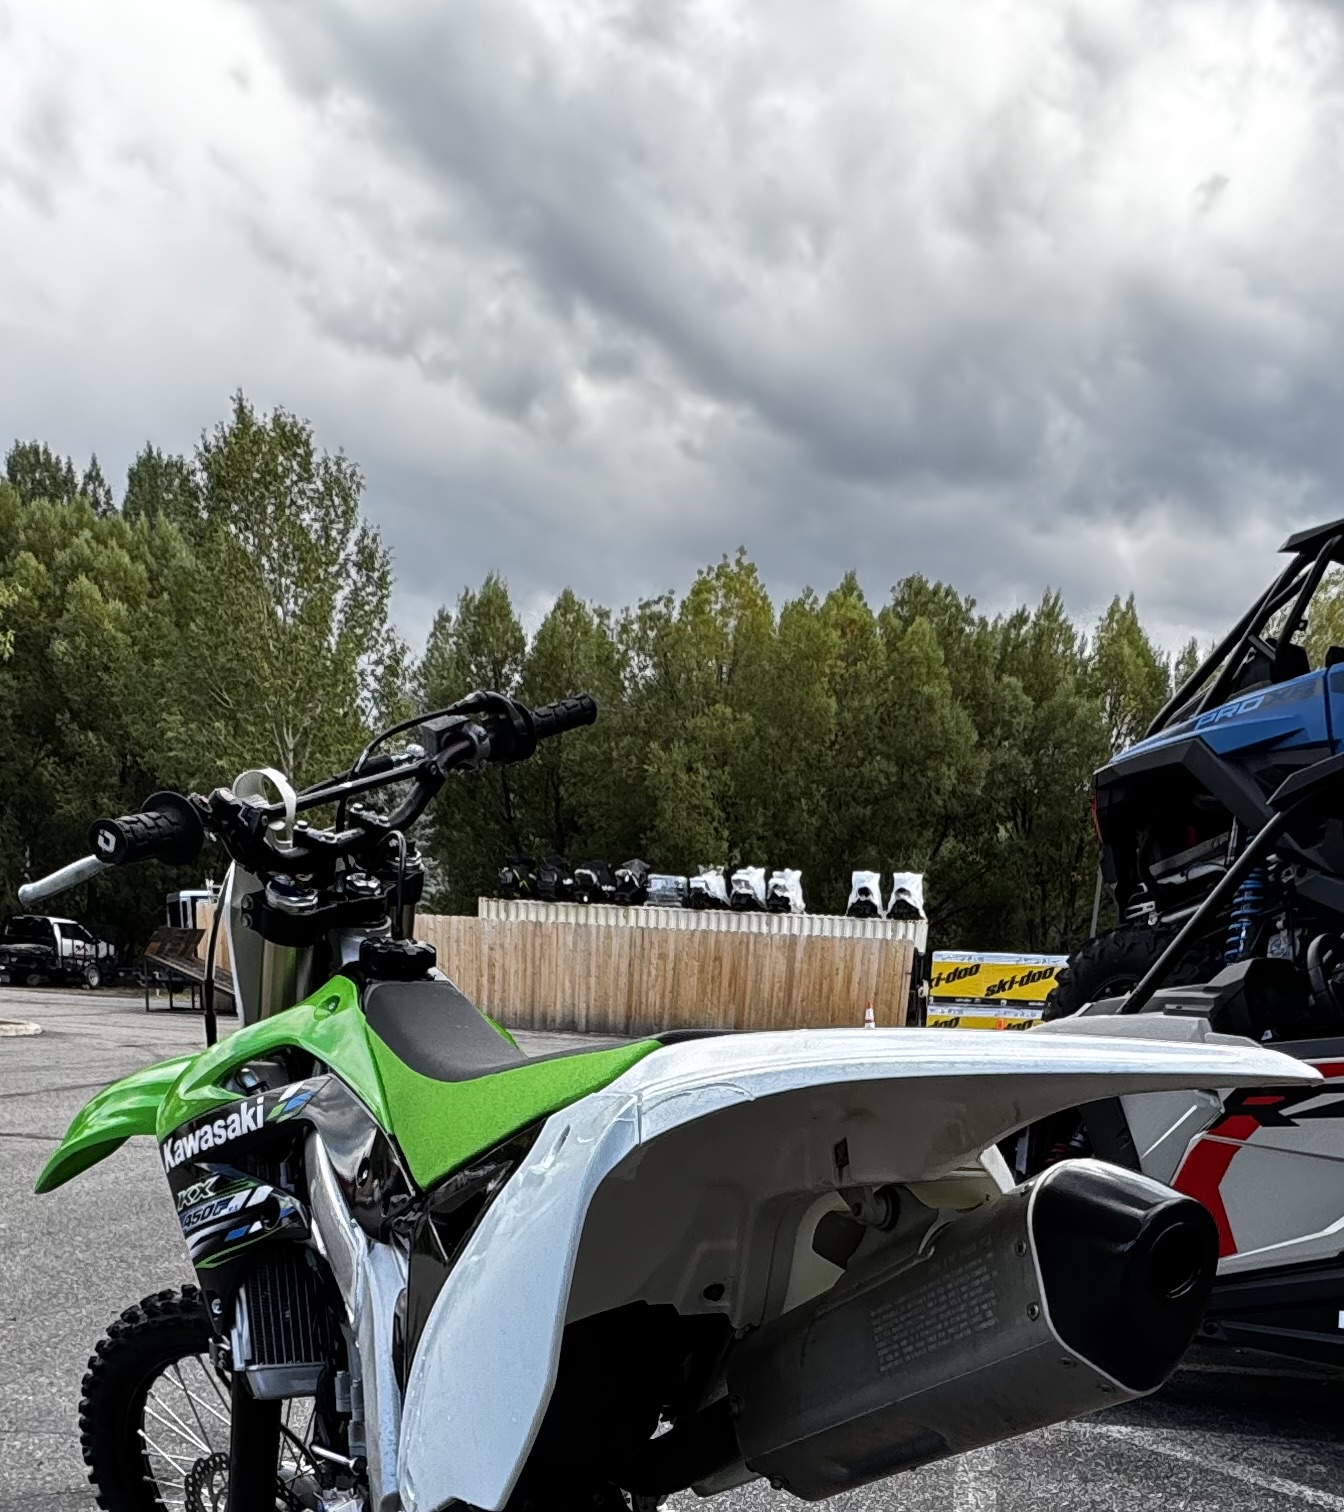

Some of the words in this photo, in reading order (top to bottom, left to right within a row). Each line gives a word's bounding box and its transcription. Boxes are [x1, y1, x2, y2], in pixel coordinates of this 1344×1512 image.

[1194, 694, 1266, 731] PRO
[929, 963, 981, 990] ki-doo
[984, 966, 1055, 998] ski-doo
[162, 1095, 265, 1174] Kawasaki
[177, 1175, 221, 1211] KX
